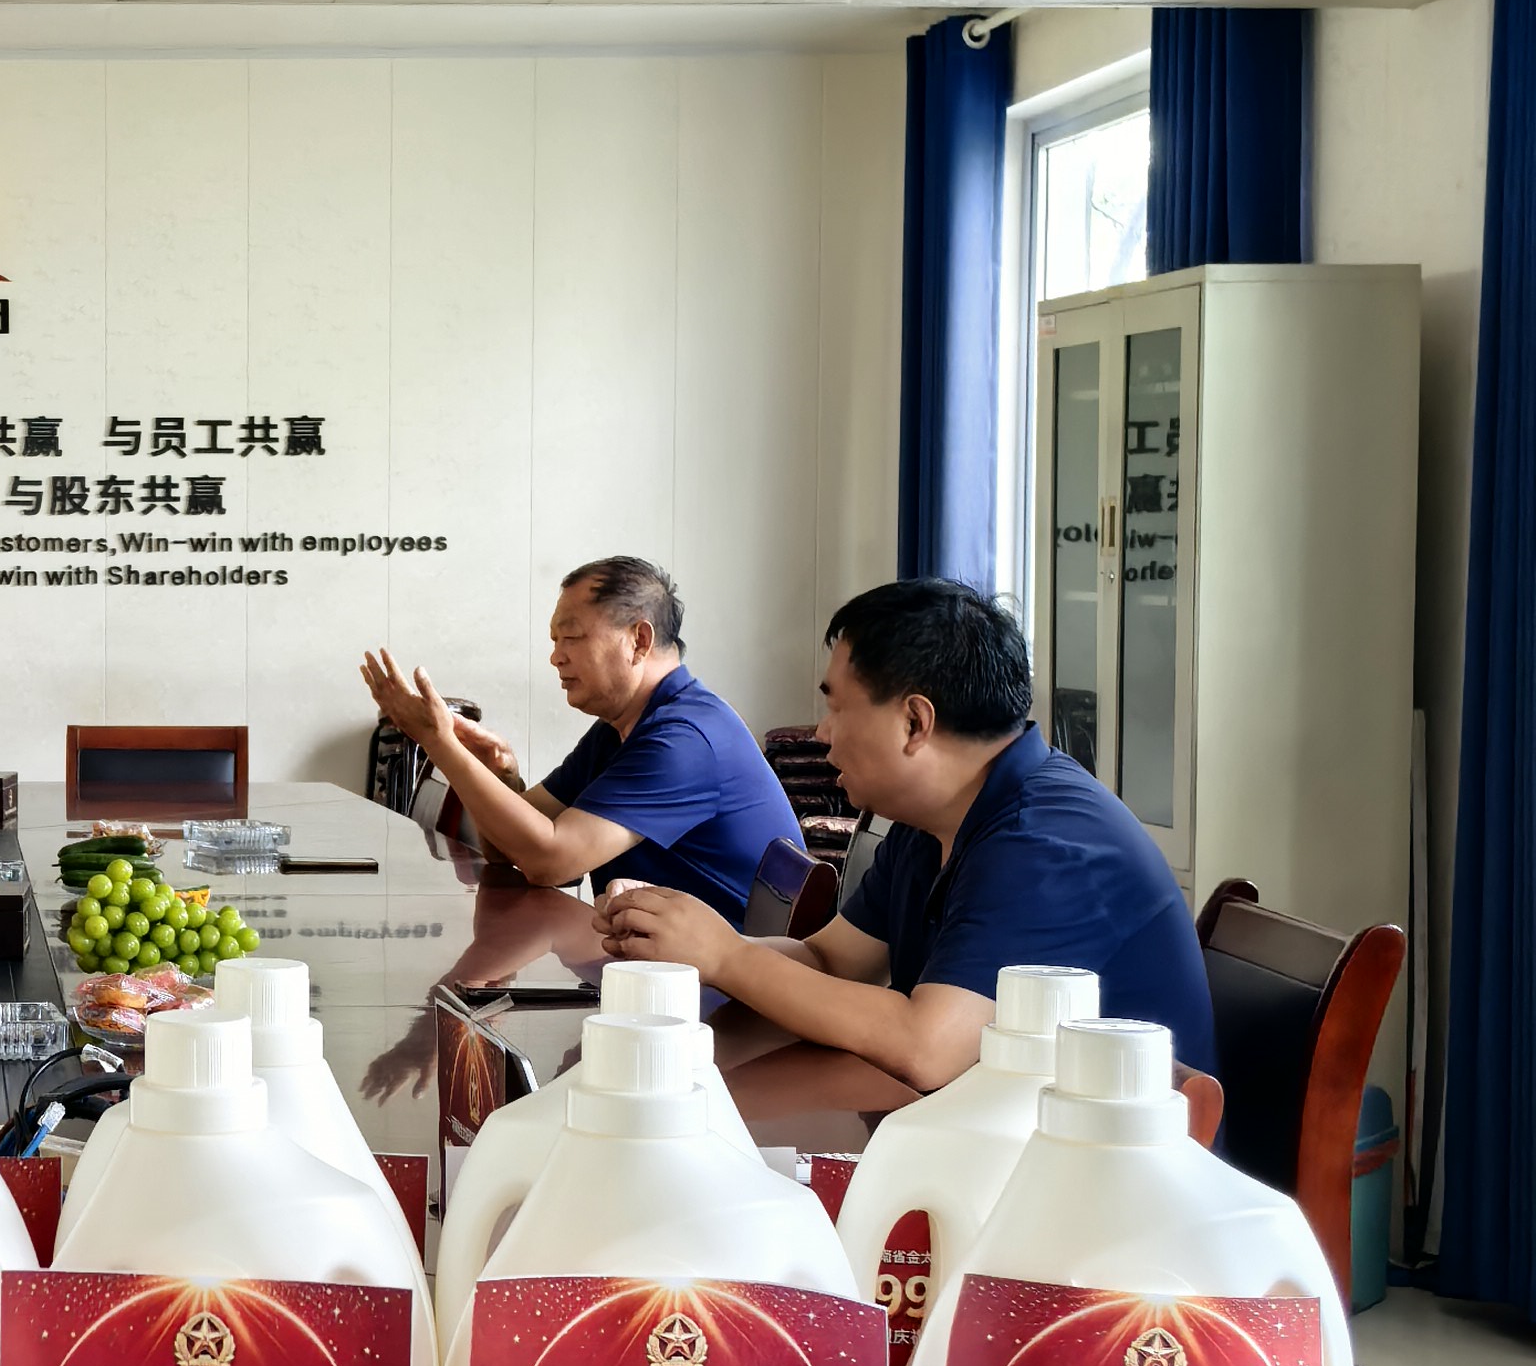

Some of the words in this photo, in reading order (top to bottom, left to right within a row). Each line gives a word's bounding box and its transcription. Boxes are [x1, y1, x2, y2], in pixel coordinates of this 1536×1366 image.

[103, 416, 325, 458] 与员工共赢
[5, 475, 226, 515] 与股东共赢
[241, 532, 293, 552] with
[303, 534, 447, 555] employees
[45, 566, 97, 585] with
[108, 565, 287, 585] Shareholders
